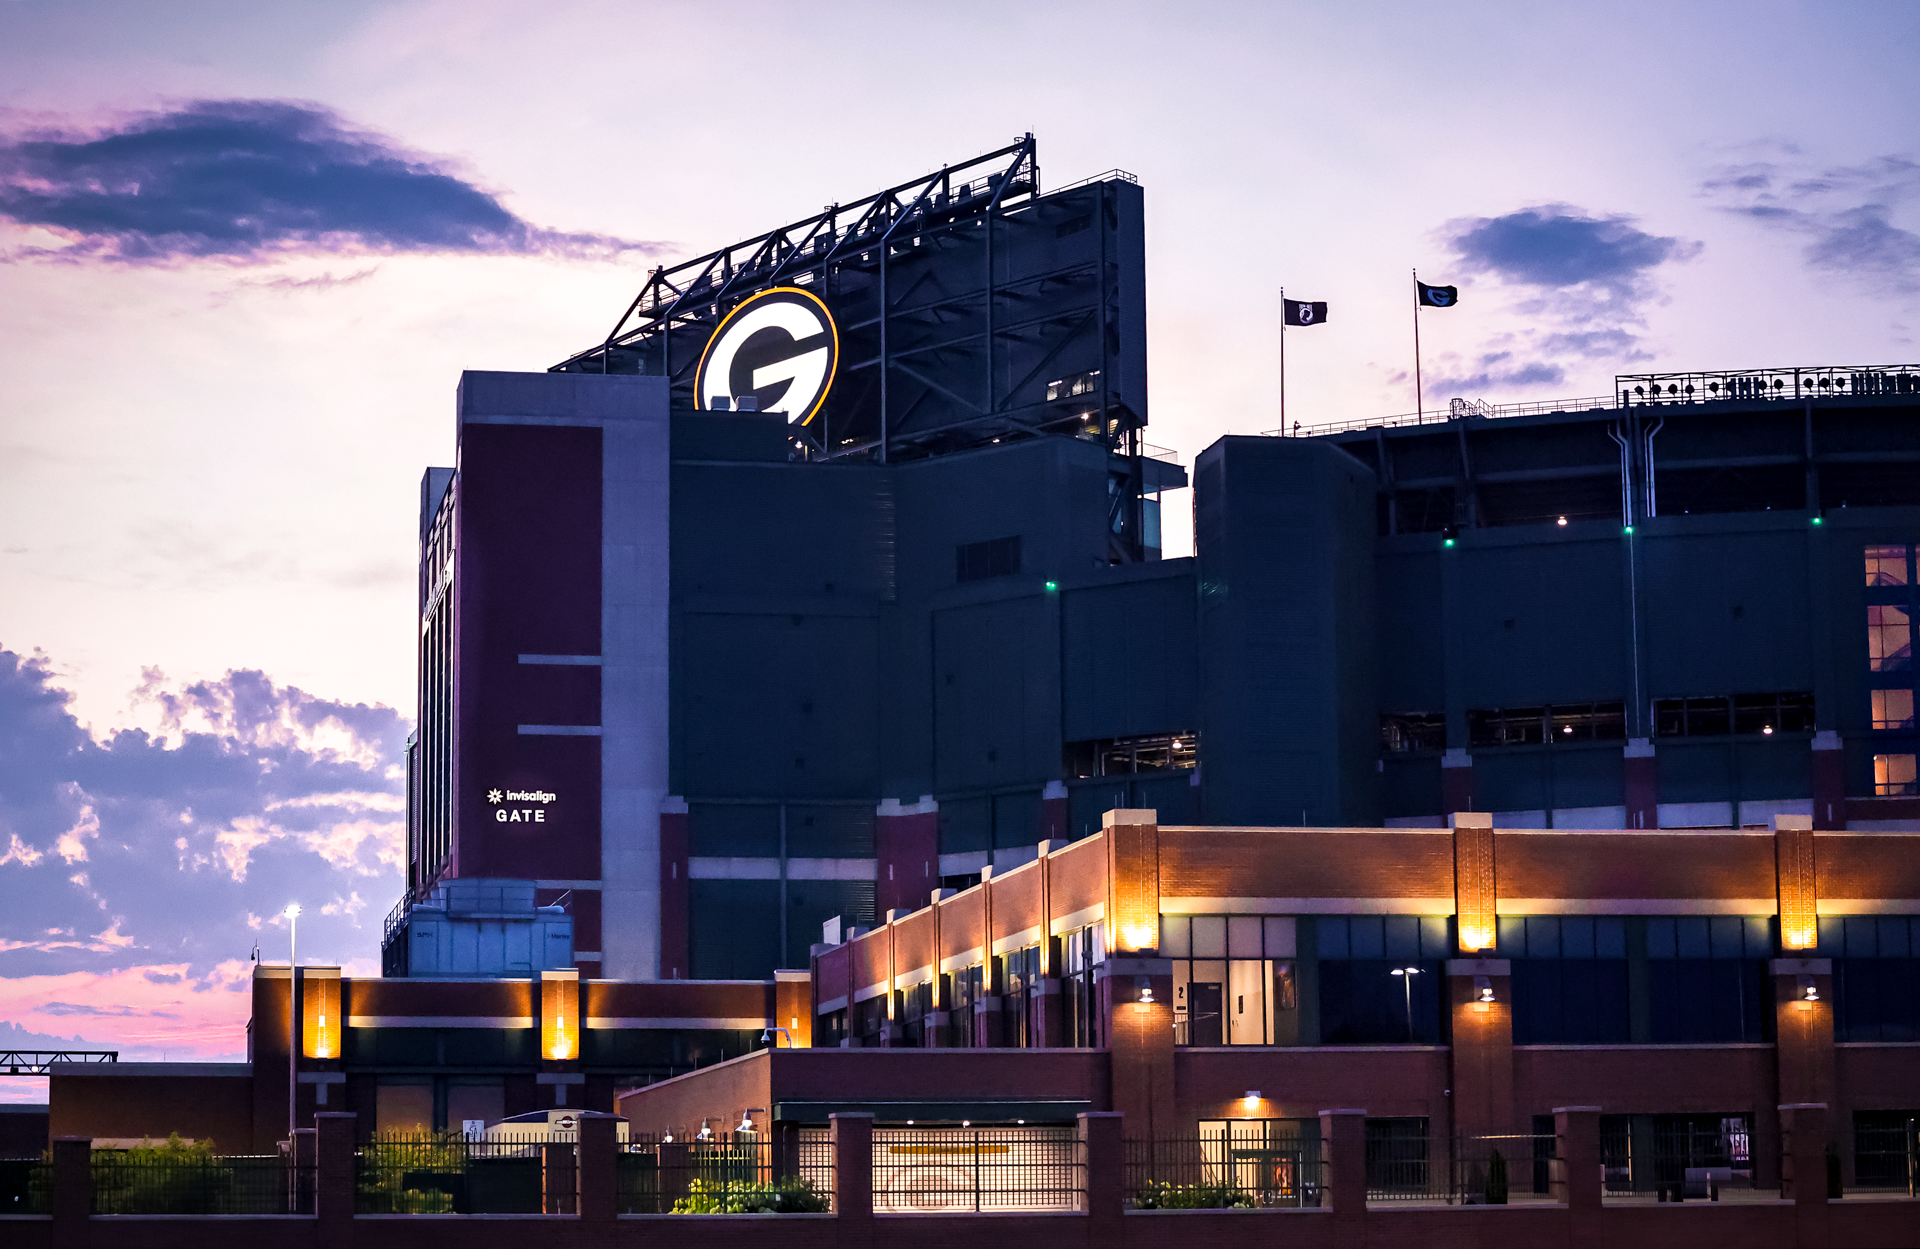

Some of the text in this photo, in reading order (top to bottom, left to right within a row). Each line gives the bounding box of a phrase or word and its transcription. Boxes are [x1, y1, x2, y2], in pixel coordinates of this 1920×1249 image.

[507, 790, 556, 804] invisalign
[496, 809, 545, 822] GATE
[1178, 986, 1184, 999] 2
